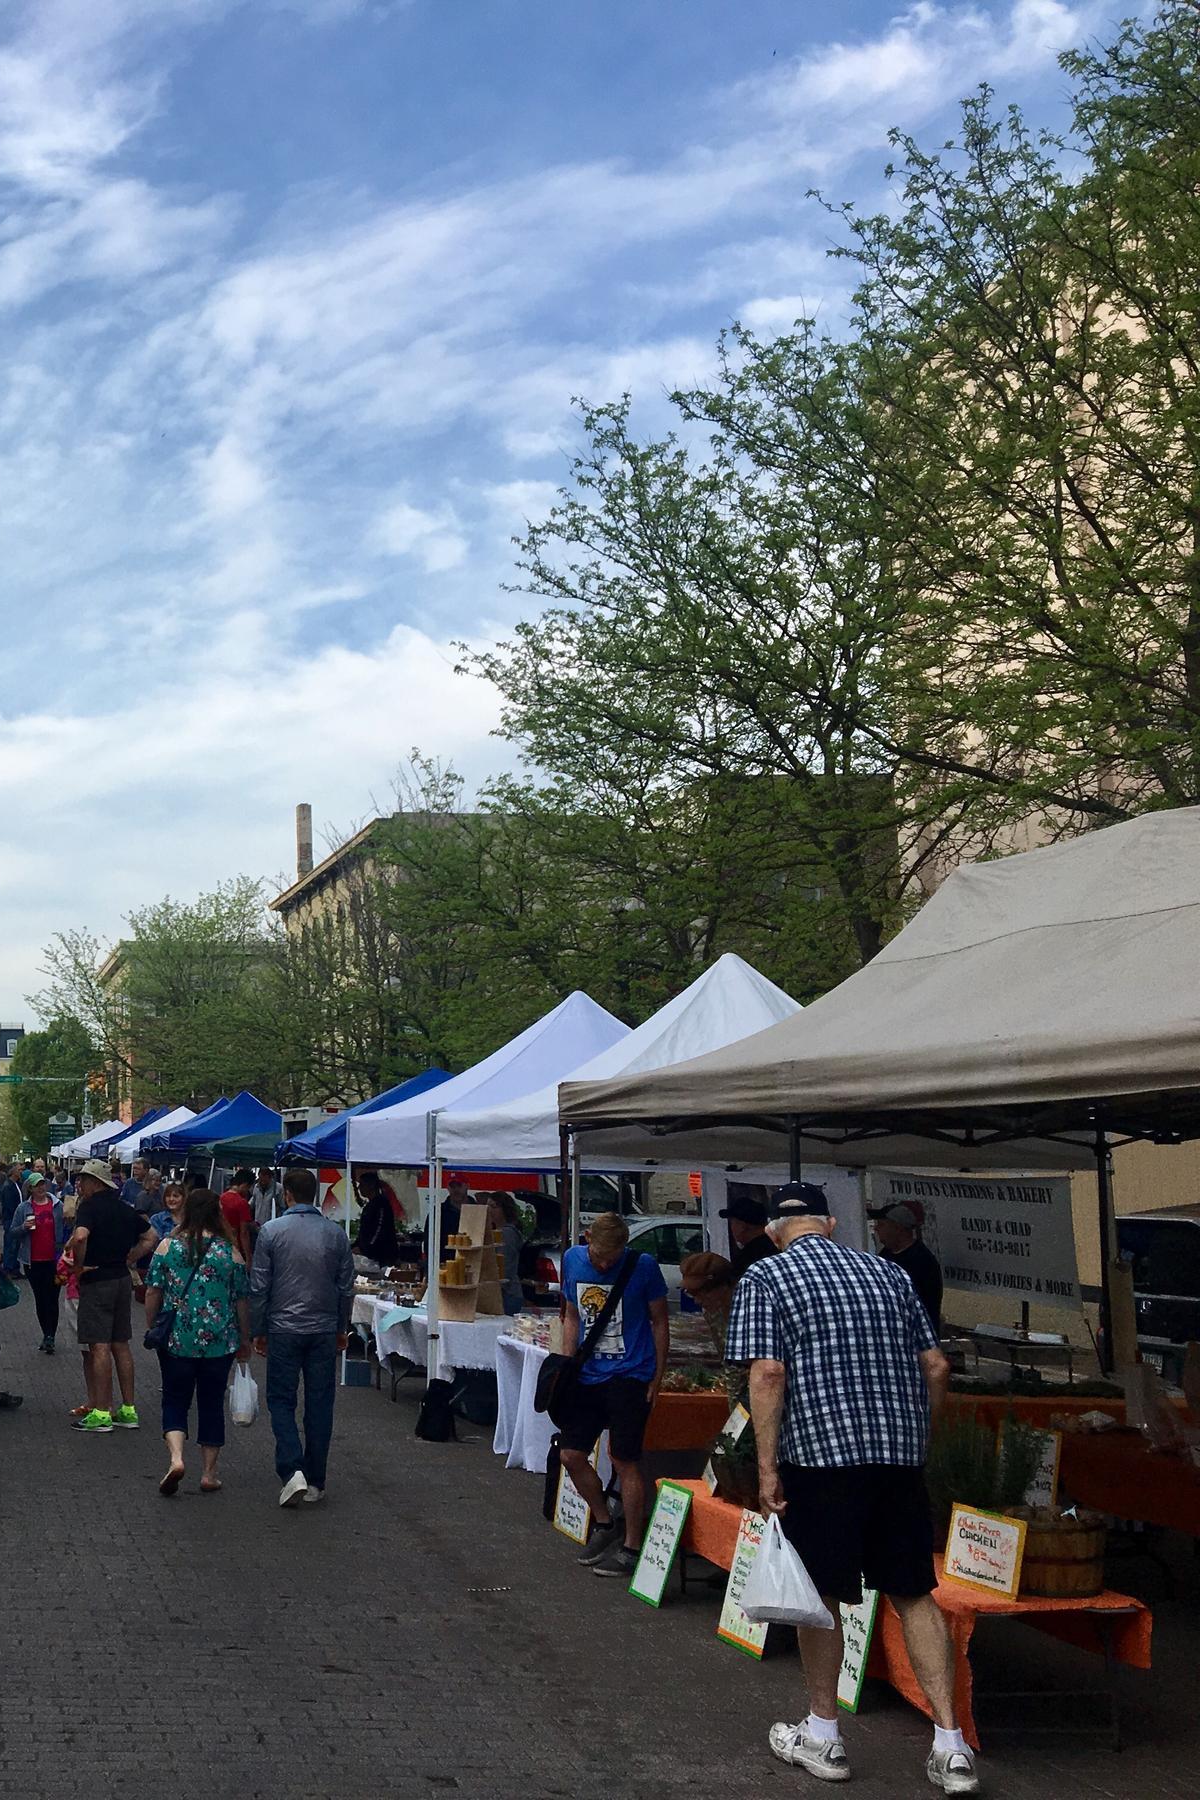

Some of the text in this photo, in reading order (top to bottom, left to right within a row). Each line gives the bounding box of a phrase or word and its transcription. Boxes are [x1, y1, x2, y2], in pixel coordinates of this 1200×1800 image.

[890, 1180, 1053, 1204] TWO GUYS CATERING & BAKERY
[961, 1217, 1031, 1237] RANDY & CHAD
[984, 1271, 1032, 1291] SAVORIES
[1035, 1278, 1042, 1292] &
[1045, 1279, 1074, 1297] MORE
[959, 1527, 997, 1549] CHICKEN
